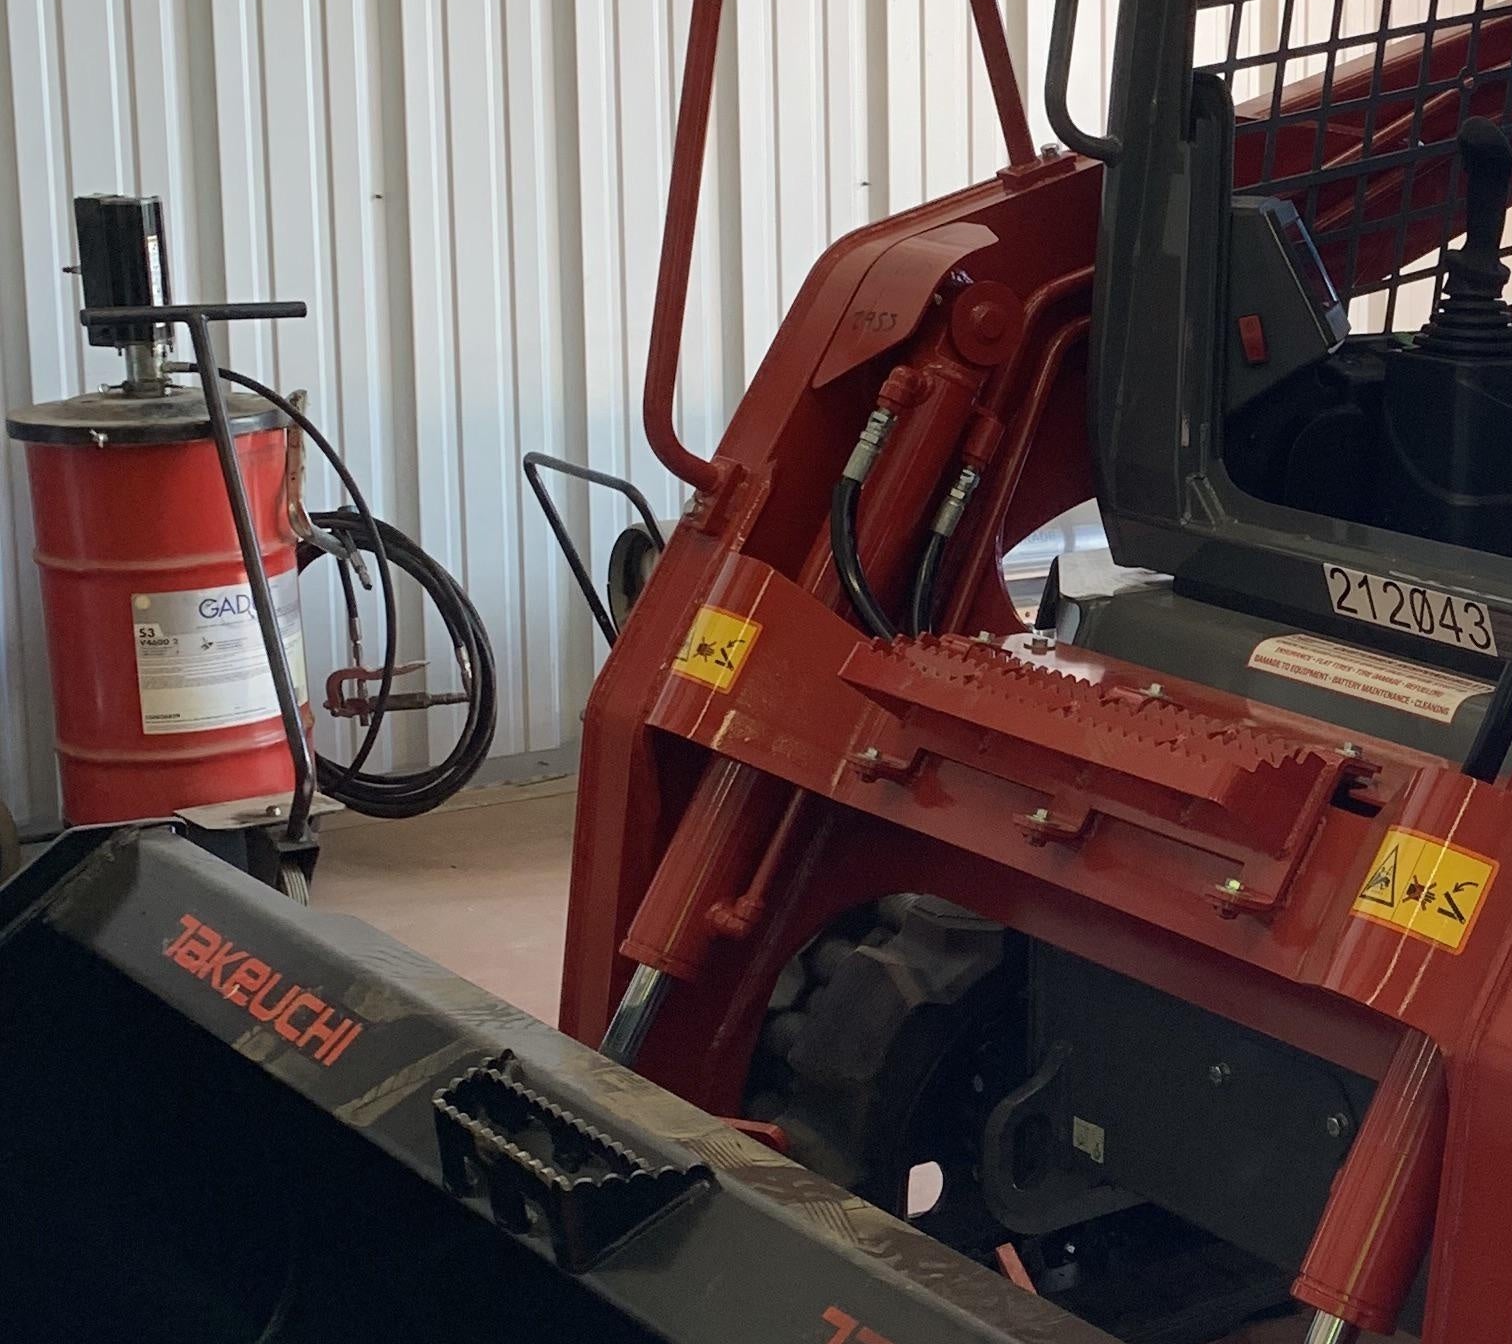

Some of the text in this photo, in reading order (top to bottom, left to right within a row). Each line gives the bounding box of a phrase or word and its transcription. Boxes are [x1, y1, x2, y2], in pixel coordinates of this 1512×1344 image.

[199, 594, 257, 619] GAD
[1330, 567, 1491, 650] 212043
[139, 628, 156, 638] S3
[1281, 662, 1290, 671] TO
[1290, 663, 1330, 680] EQUIPMENT
[1332, 676, 1361, 690] BATTERY
[1361, 684, 1411, 706] MAINTENANCE
[1414, 699, 1451, 716] CLEANING
